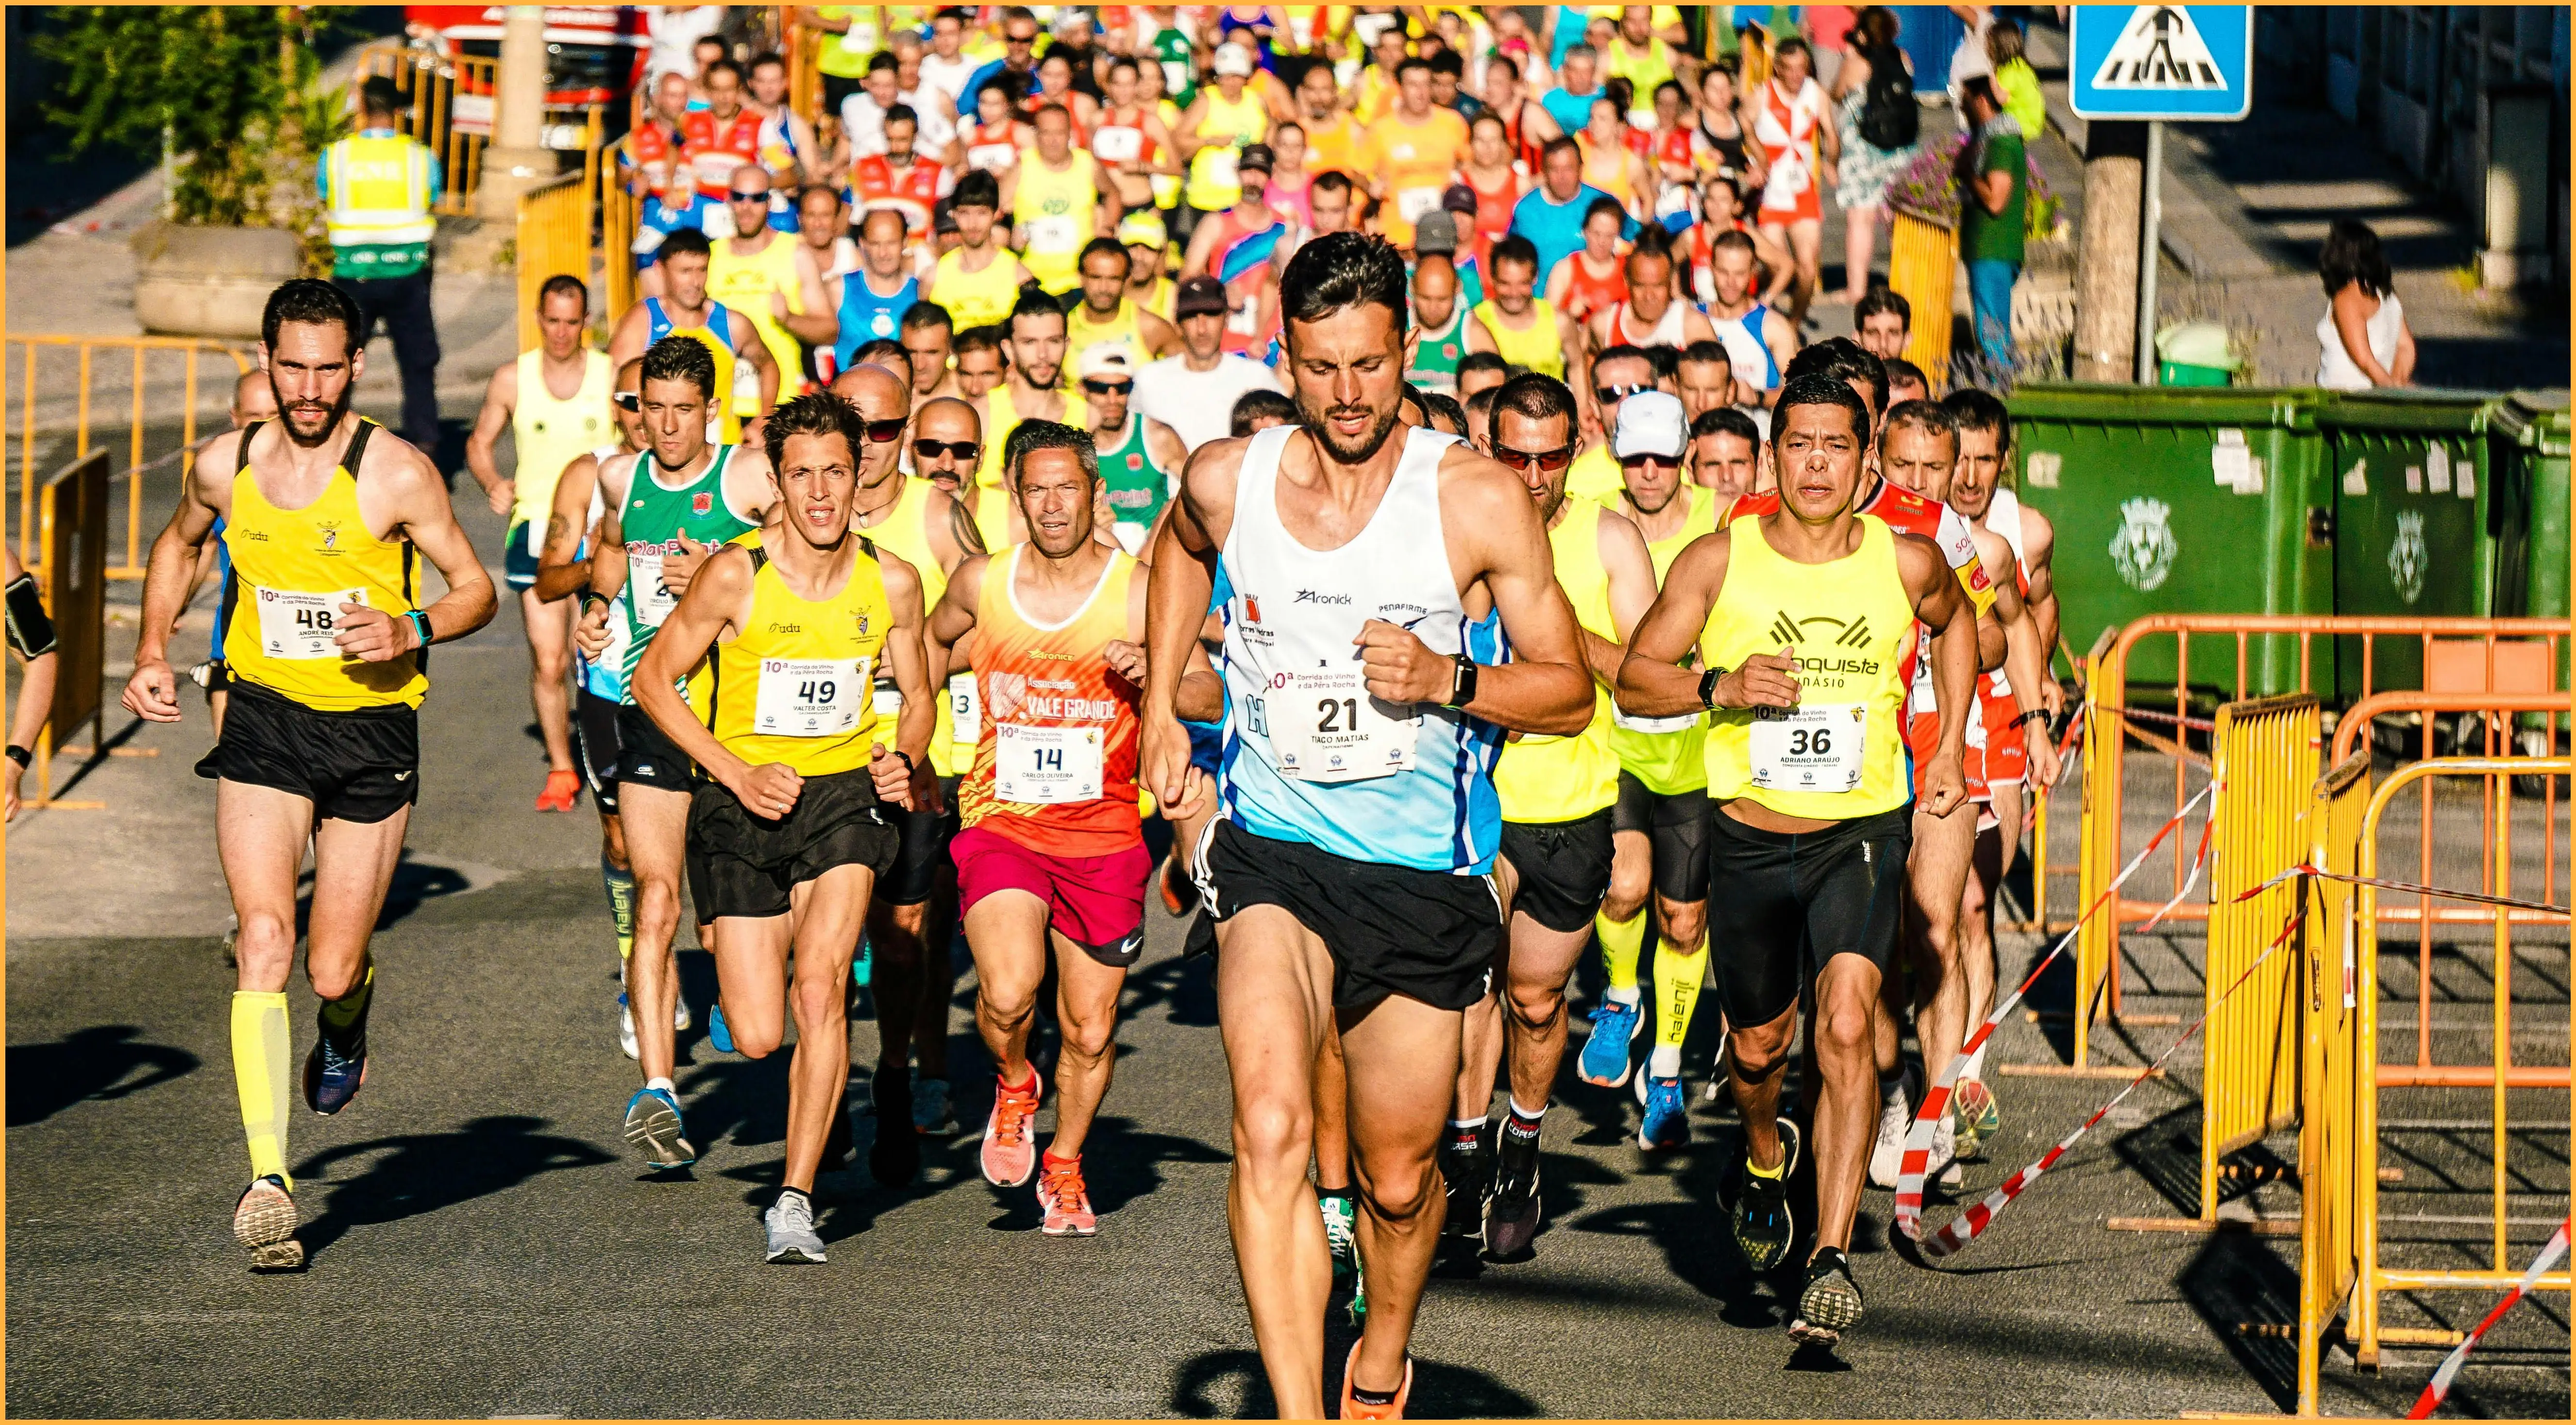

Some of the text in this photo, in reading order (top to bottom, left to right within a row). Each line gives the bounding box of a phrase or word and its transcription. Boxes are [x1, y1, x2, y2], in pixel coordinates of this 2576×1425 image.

[260, 590, 280, 602] 10ª
[1296, 590, 1351, 605] Aronick
[296, 609, 332, 629] 48
[779, 623, 801, 633] udu
[765, 661, 788, 673] 10ª
[798, 680, 836, 704] 49
[1027, 677, 1075, 692] Associação
[1027, 696, 1116, 720] VALE GRANDE
[1318, 698, 1356, 732] 21
[1753, 705, 1777, 719] 10ª
[1000, 727, 1018, 738] 10ª
[1336, 734, 1368, 743] MATIAS
[1789, 729, 1831, 755] 36
[1034, 748, 1062, 771] 14
